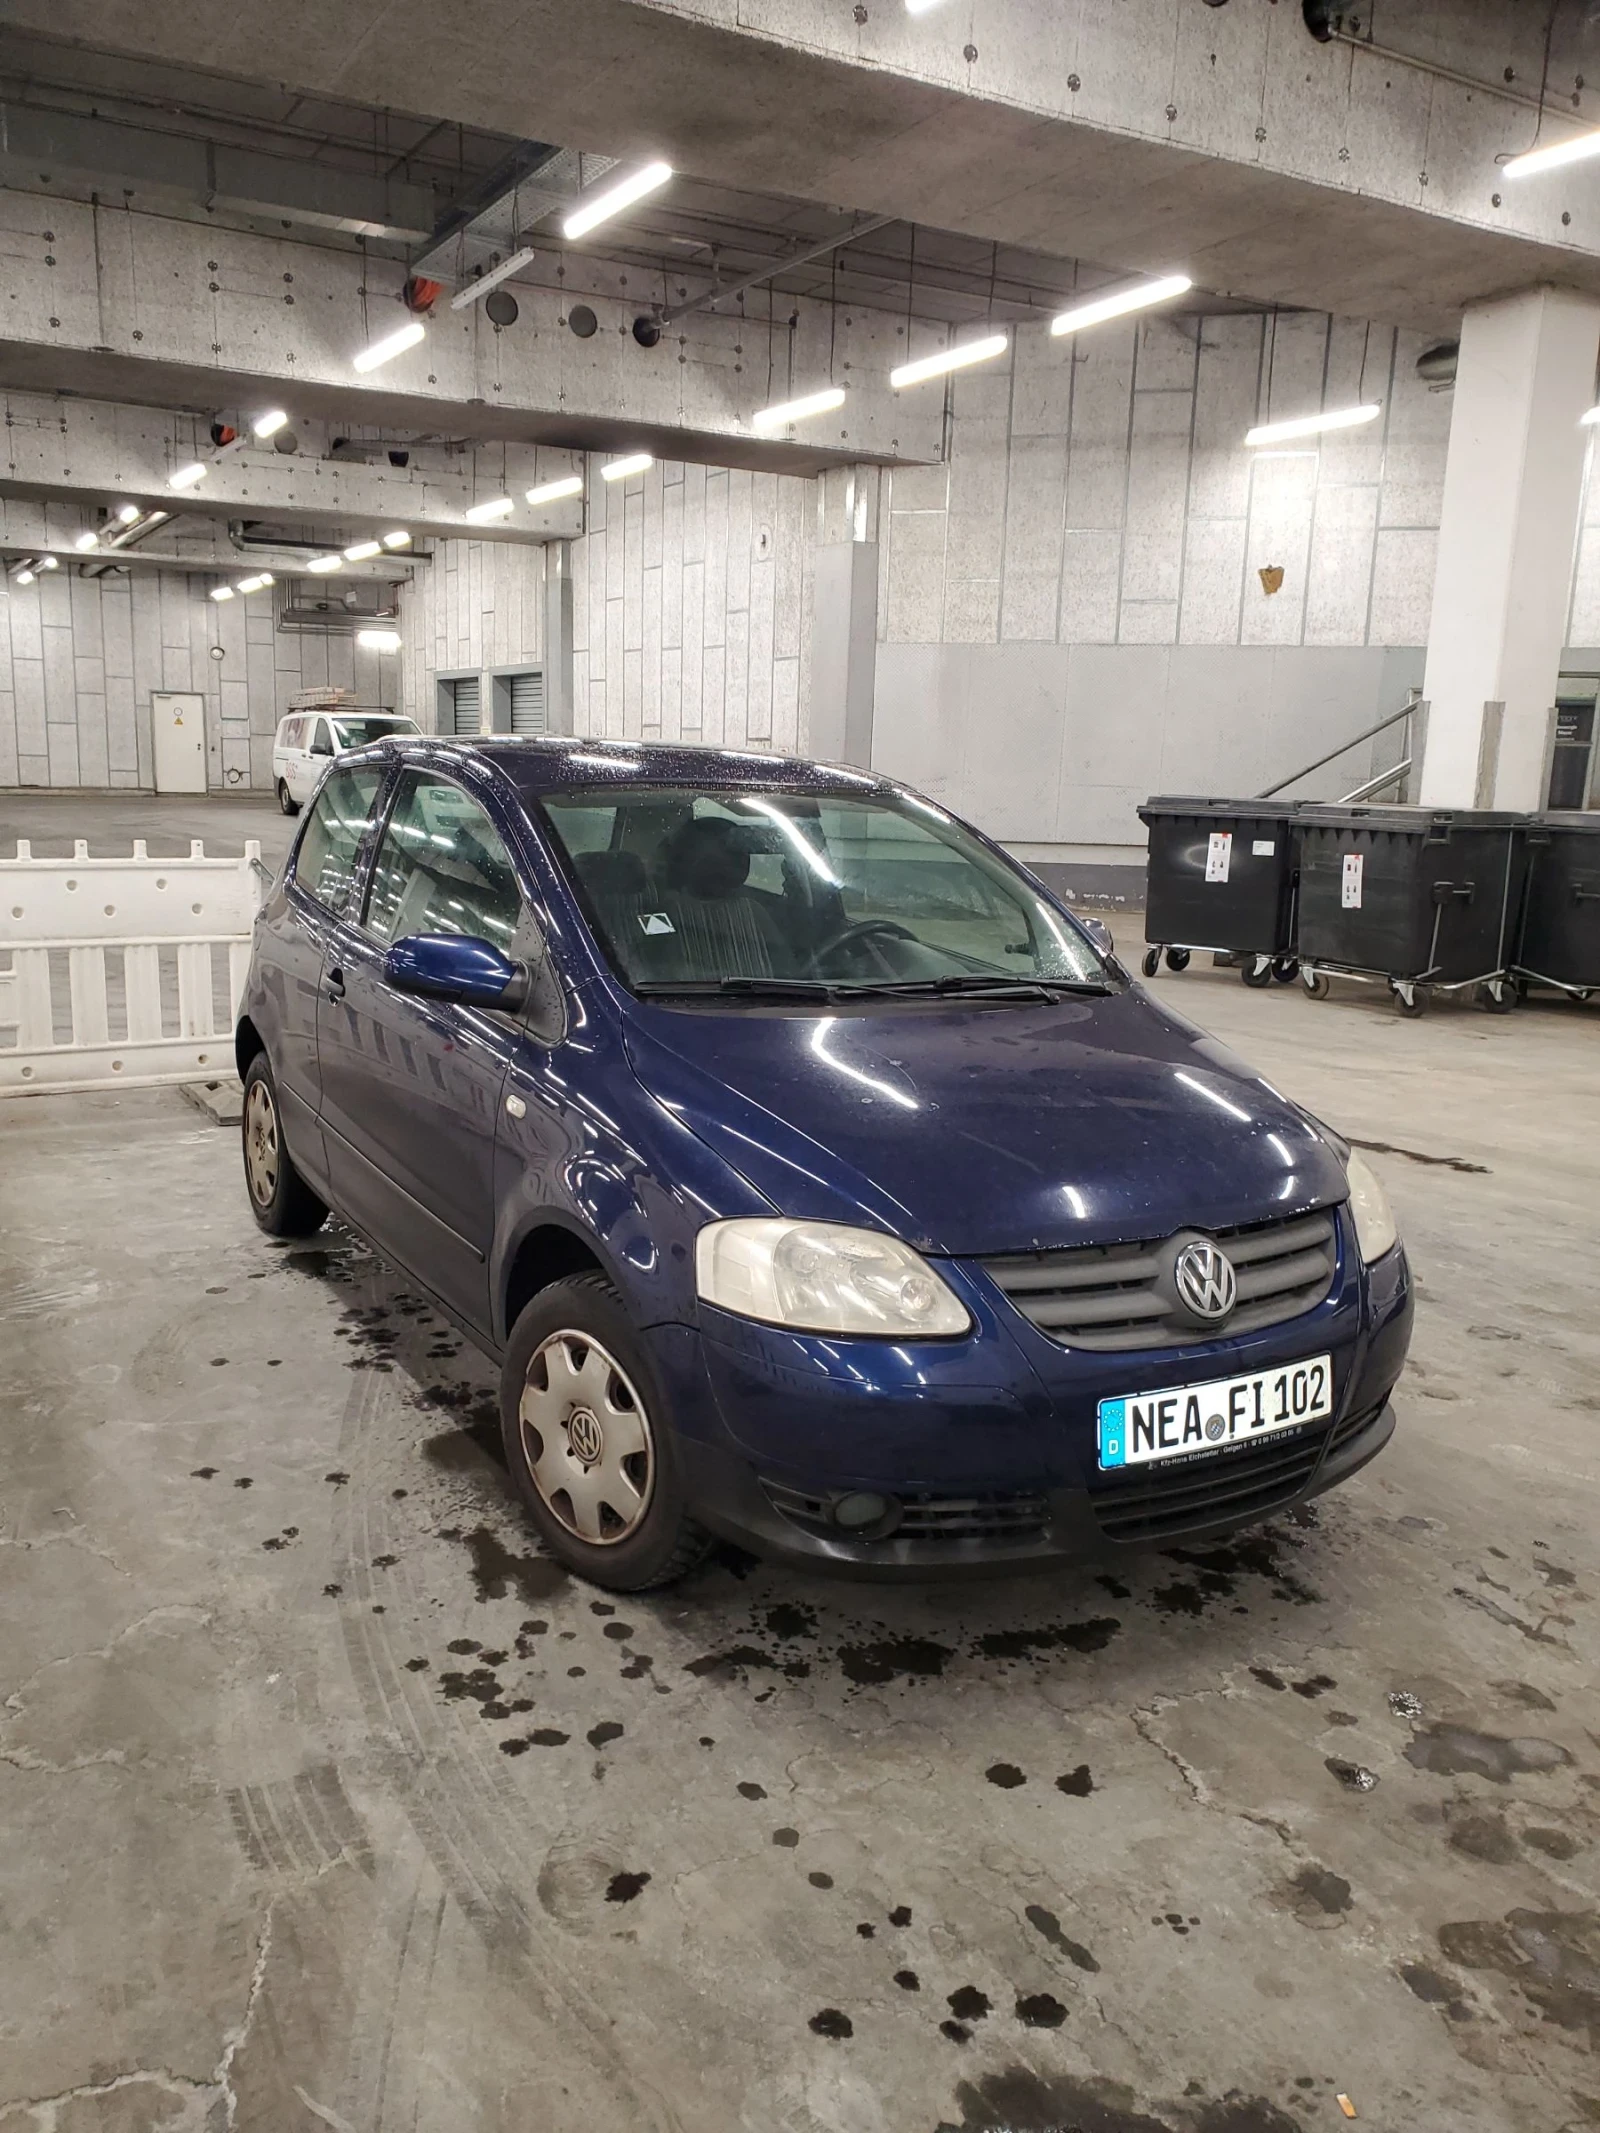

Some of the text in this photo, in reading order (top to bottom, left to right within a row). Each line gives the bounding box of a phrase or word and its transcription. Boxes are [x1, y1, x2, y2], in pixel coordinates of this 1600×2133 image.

[1175, 1242, 1236, 1318] VW
[571, 1411, 600, 1461] VW
[1132, 1365, 1325, 1453] NEA FI 102
[1108, 1439, 1119, 1455] D
